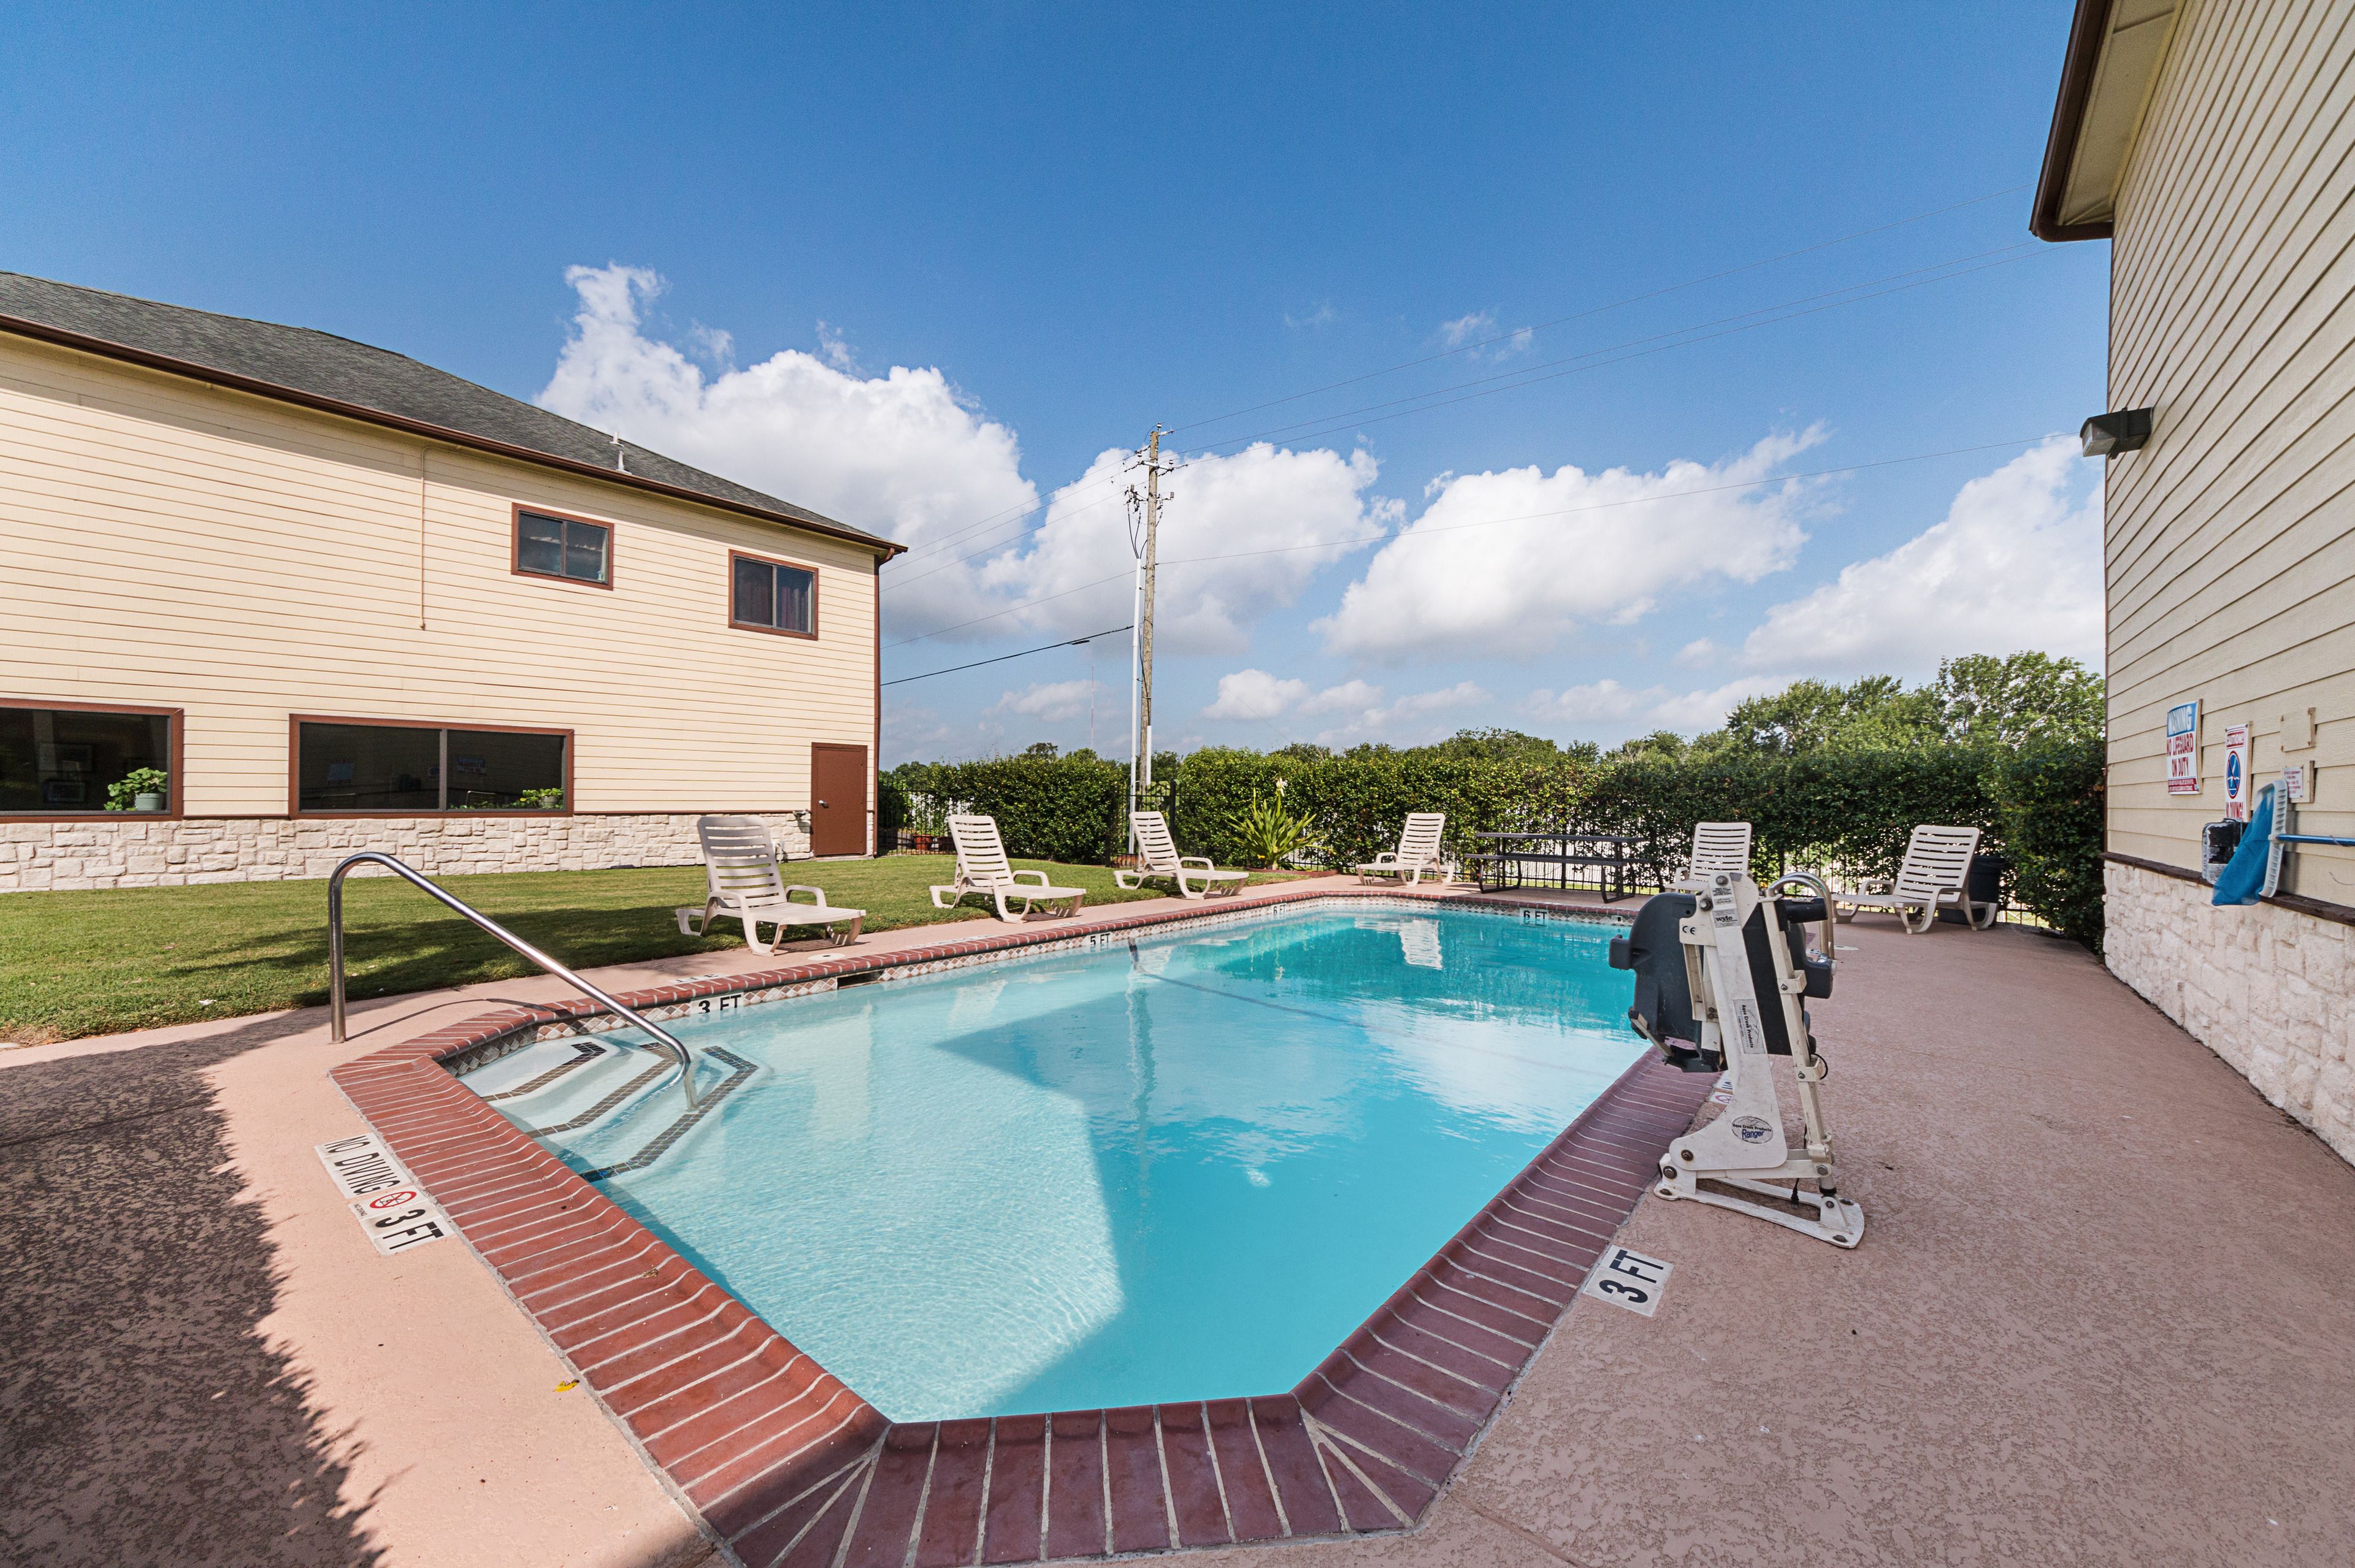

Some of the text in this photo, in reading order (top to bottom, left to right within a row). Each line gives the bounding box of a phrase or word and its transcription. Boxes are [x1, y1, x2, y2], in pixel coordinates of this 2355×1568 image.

[2168, 706, 2192, 735] WARNING
[2167, 733, 2193, 757] NO LIFEGUARD
[2172, 757, 2189, 777] ON DUTY
[1280, 904, 1286, 913] FT
[1090, 933, 1111, 945] 5 FT
[1682, 925, 1696, 936] CE
[698, 994, 742, 1014] 3 FT
[1742, 1129, 1765, 1139] Ranger
[324, 1135, 400, 1196] NO DIVING
[375, 1209, 444, 1250] 3 FT
[1599, 1249, 1664, 1303] 3 FT
